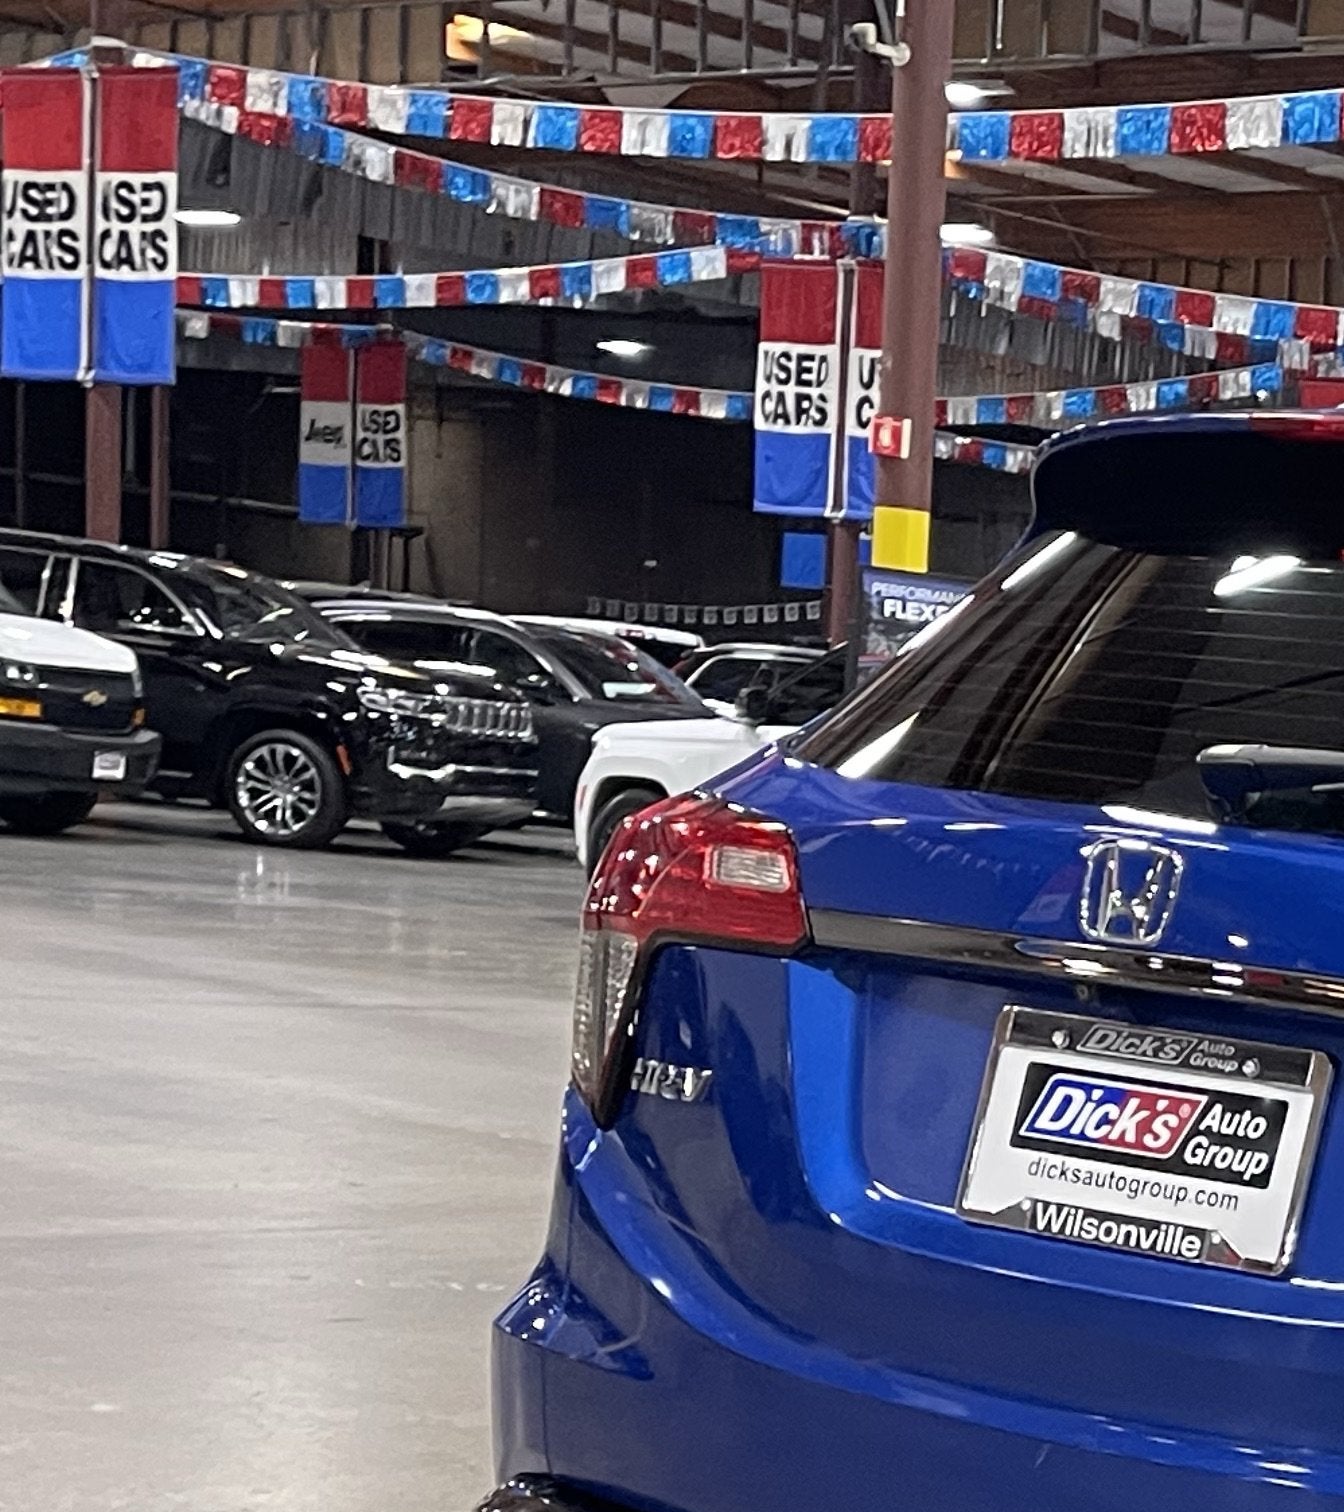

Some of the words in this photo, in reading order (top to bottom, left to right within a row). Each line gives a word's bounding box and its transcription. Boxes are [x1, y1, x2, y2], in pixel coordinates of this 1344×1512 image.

[763, 351, 830, 388] USED
[761, 390, 829, 427] CARS
[1189, 1052, 1239, 1073] Group
[1198, 1039, 1236, 1057] Auto
[1199, 1103, 1268, 1140] Auto
[1184, 1137, 1269, 1181] Group
[1028, 1156, 1239, 1211] dicksautogroup.com
[1035, 1201, 1202, 1258] Wilsonville
